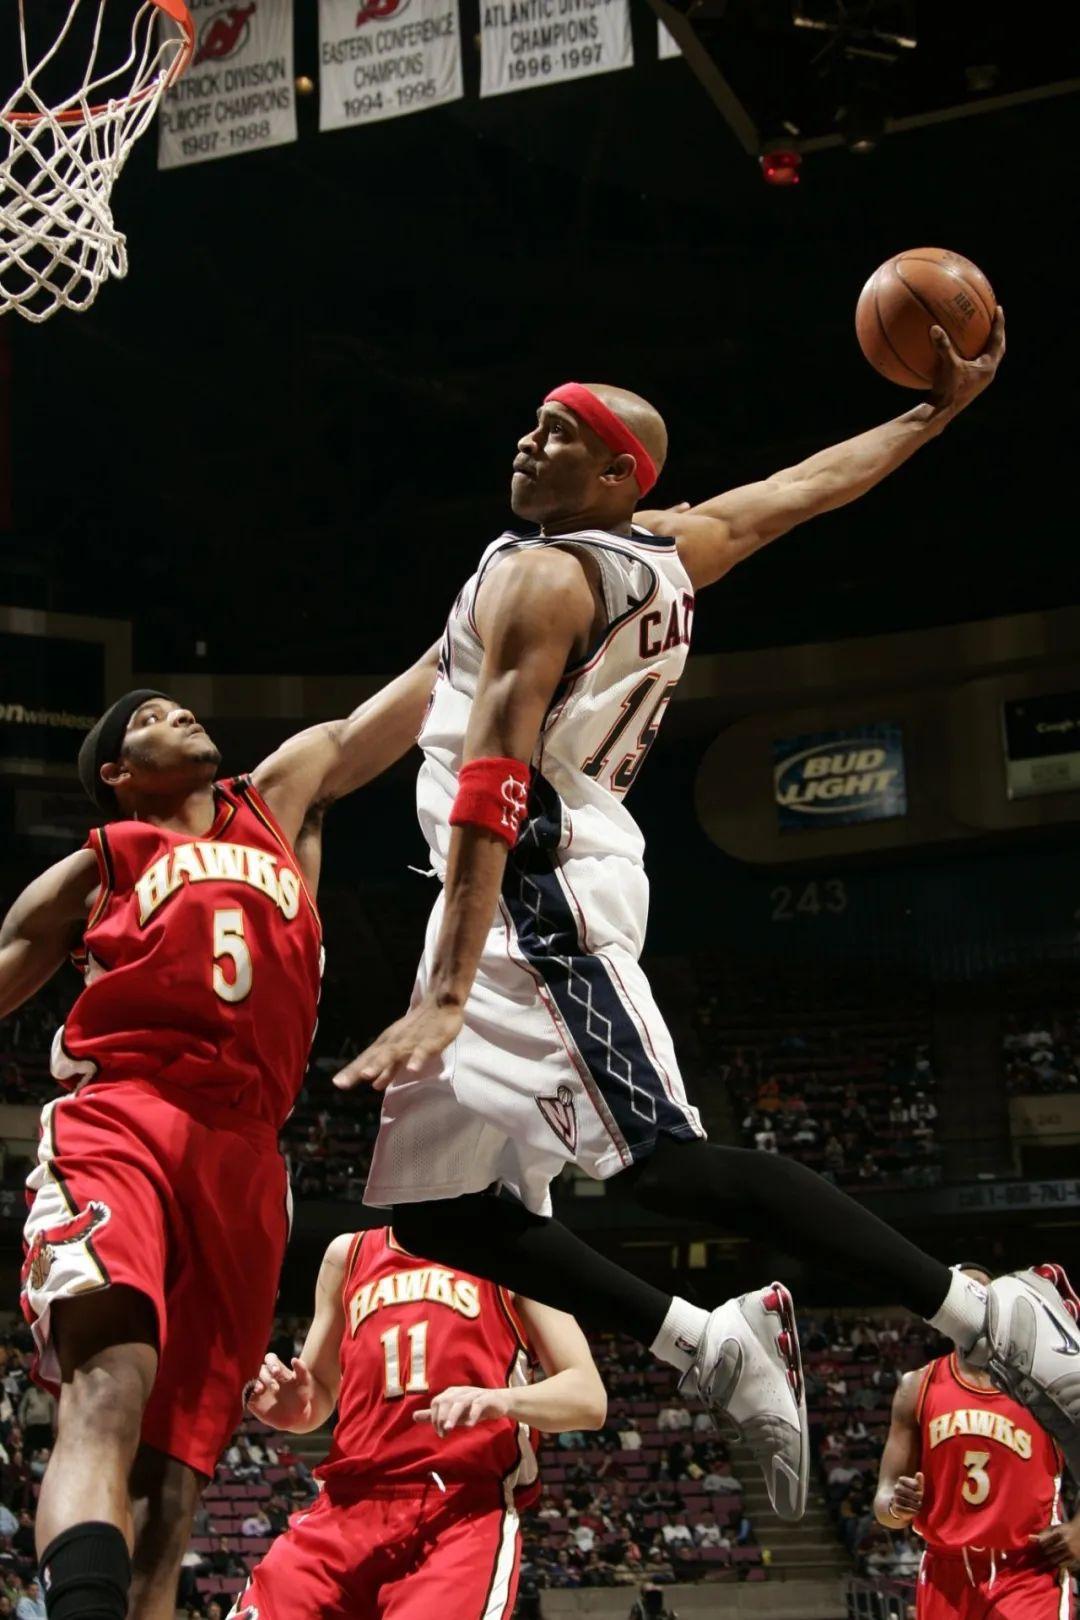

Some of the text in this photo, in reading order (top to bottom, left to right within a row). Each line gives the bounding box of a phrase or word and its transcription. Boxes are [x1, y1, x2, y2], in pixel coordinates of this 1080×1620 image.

[484, 0, 556, 28] ATLANTIC
[510, 15, 599, 55] CHAMPIONS
[322, 11, 453, 66] EASTERN CONFERENCE
[224, 57, 286, 93] DIVISION
[354, 52, 424, 90] CHAMPIONS
[214, 86, 290, 123] CHAMPIONS
[803, 748, 886, 779] BUD
[782, 769, 898, 805] LIGHT
[135, 841, 300, 927] HAWKS
[770, 878, 848, 922] 243
[212, 908, 253, 1002] 5
[349, 1266, 481, 1339] HAWKS
[380, 1320, 430, 1399] 11
[928, 1409, 1033, 1461] HAWKS
[961, 1451, 991, 1506] 3
